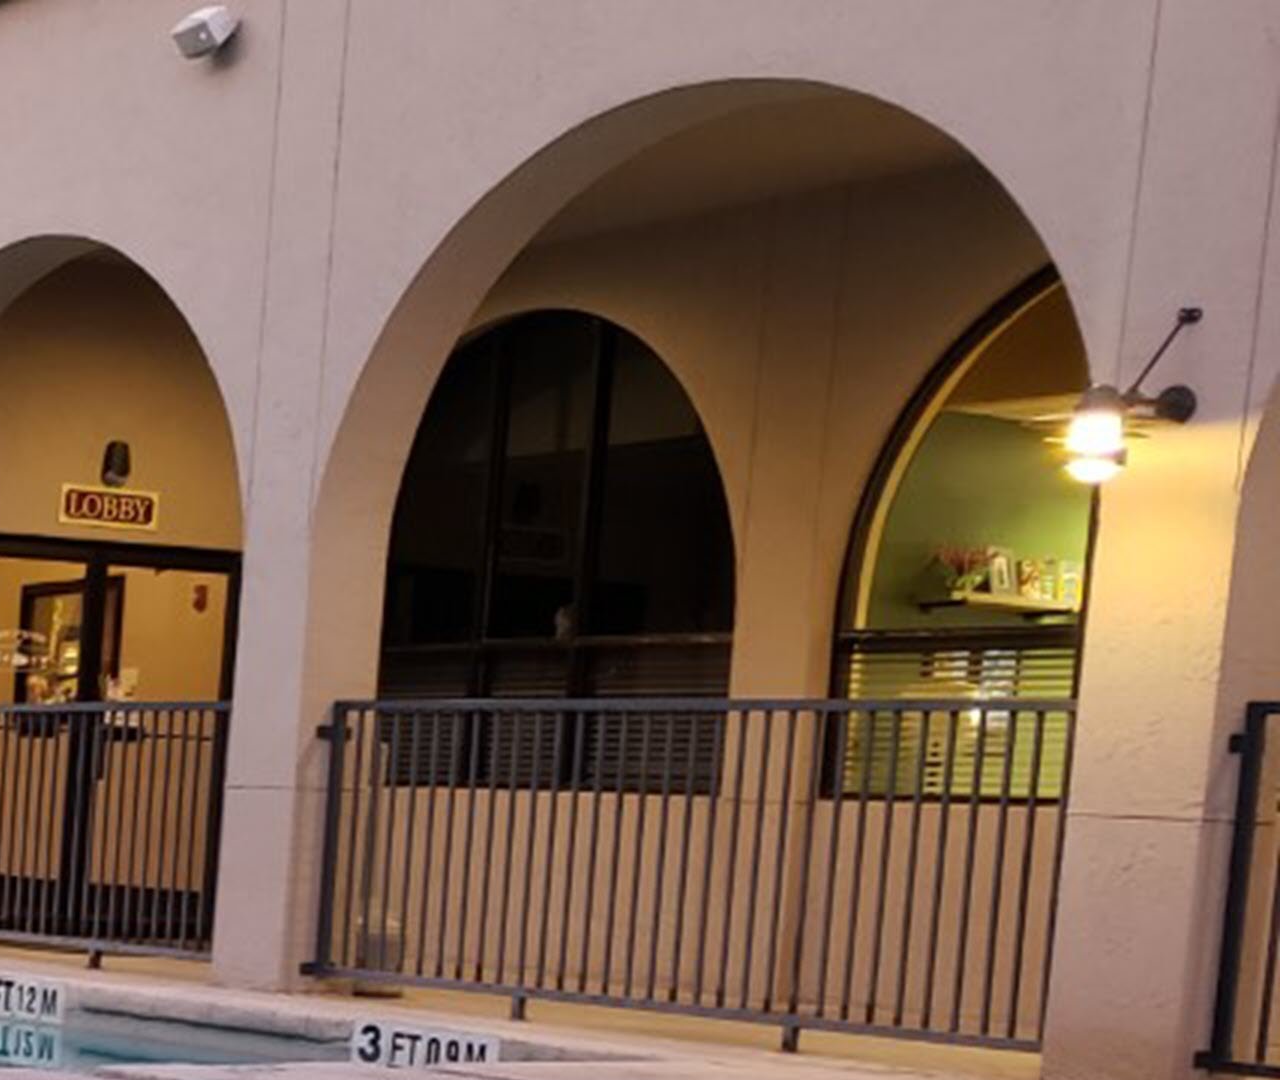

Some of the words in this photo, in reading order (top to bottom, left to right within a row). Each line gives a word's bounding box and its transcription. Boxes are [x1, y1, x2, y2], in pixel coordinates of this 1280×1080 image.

[69, 492, 150, 523] LOBBY
[357, 1024, 382, 1063] 3
[391, 1031, 423, 1066] FT
